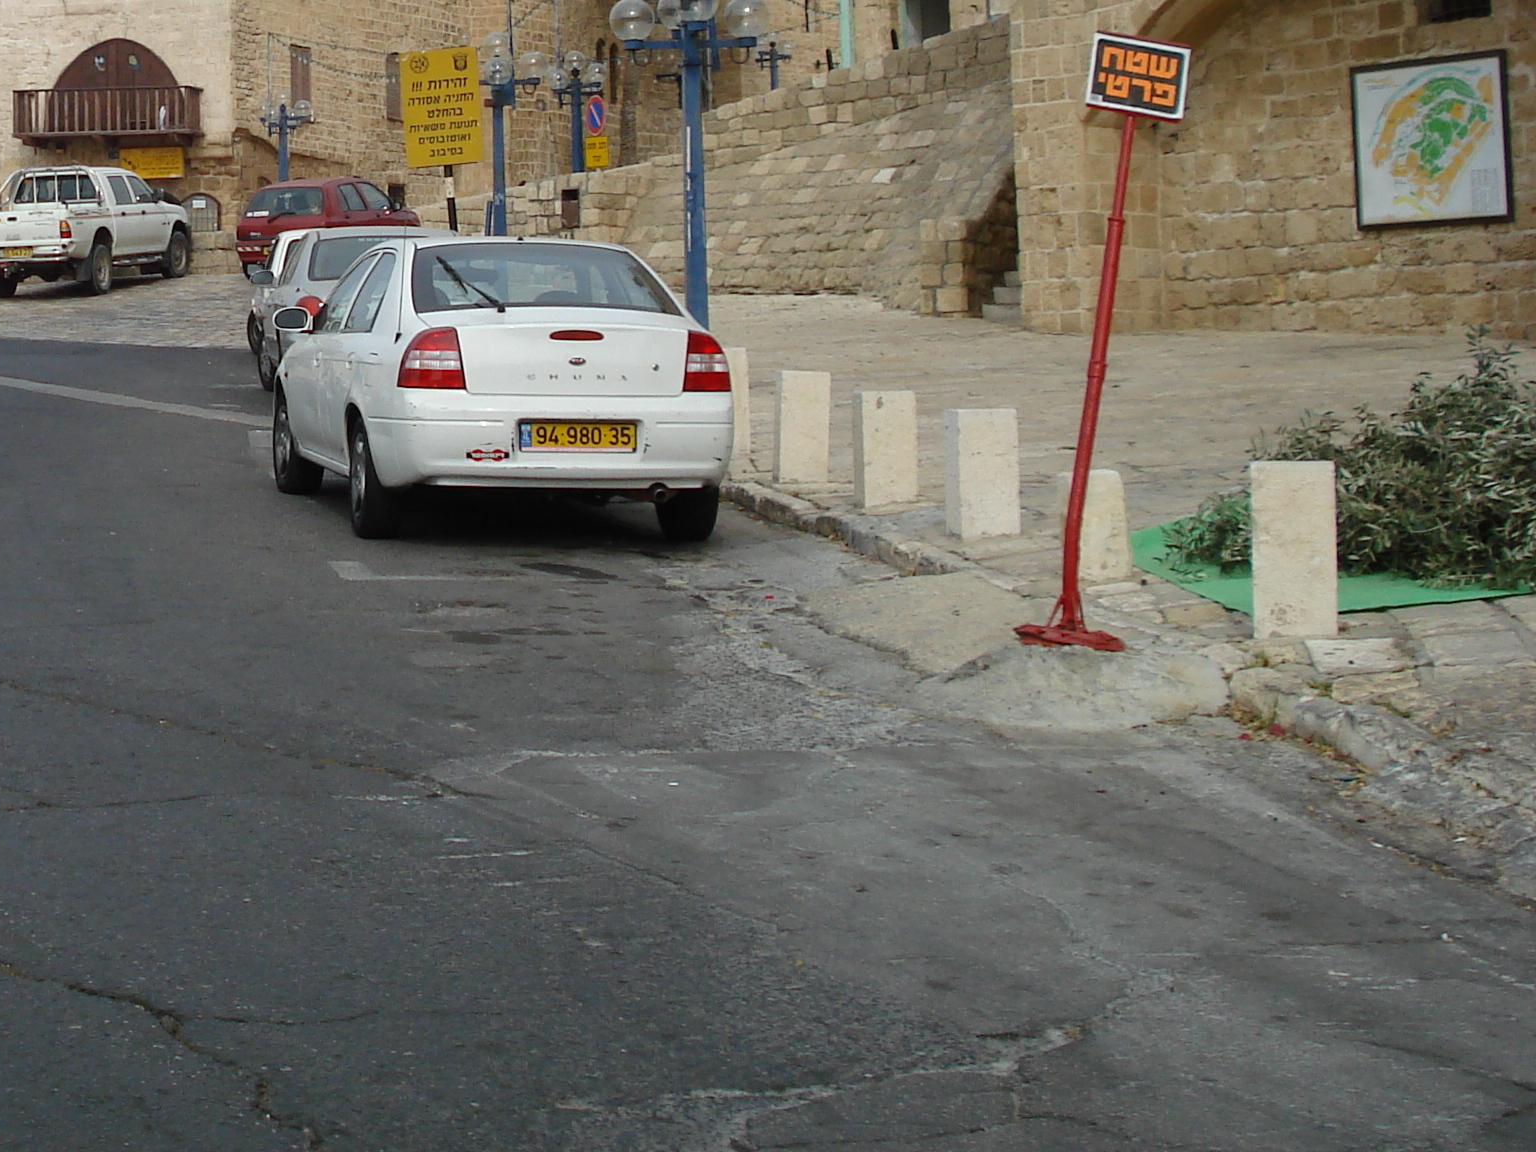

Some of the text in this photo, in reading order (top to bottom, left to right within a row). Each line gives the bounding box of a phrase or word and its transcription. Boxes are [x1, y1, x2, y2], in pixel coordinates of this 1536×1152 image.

[1101, 45, 1179, 80] שטח
[427, 77, 468, 91] זהירות
[1097, 70, 1177, 107] פרטי
[408, 92, 474, 107] החניה אסורה
[427, 107, 463, 119] בהחלט
[409, 119, 478, 134] תנועת משאיות
[418, 132, 471, 146] ואוטובוסים
[429, 146, 464, 158] בסיבוב
